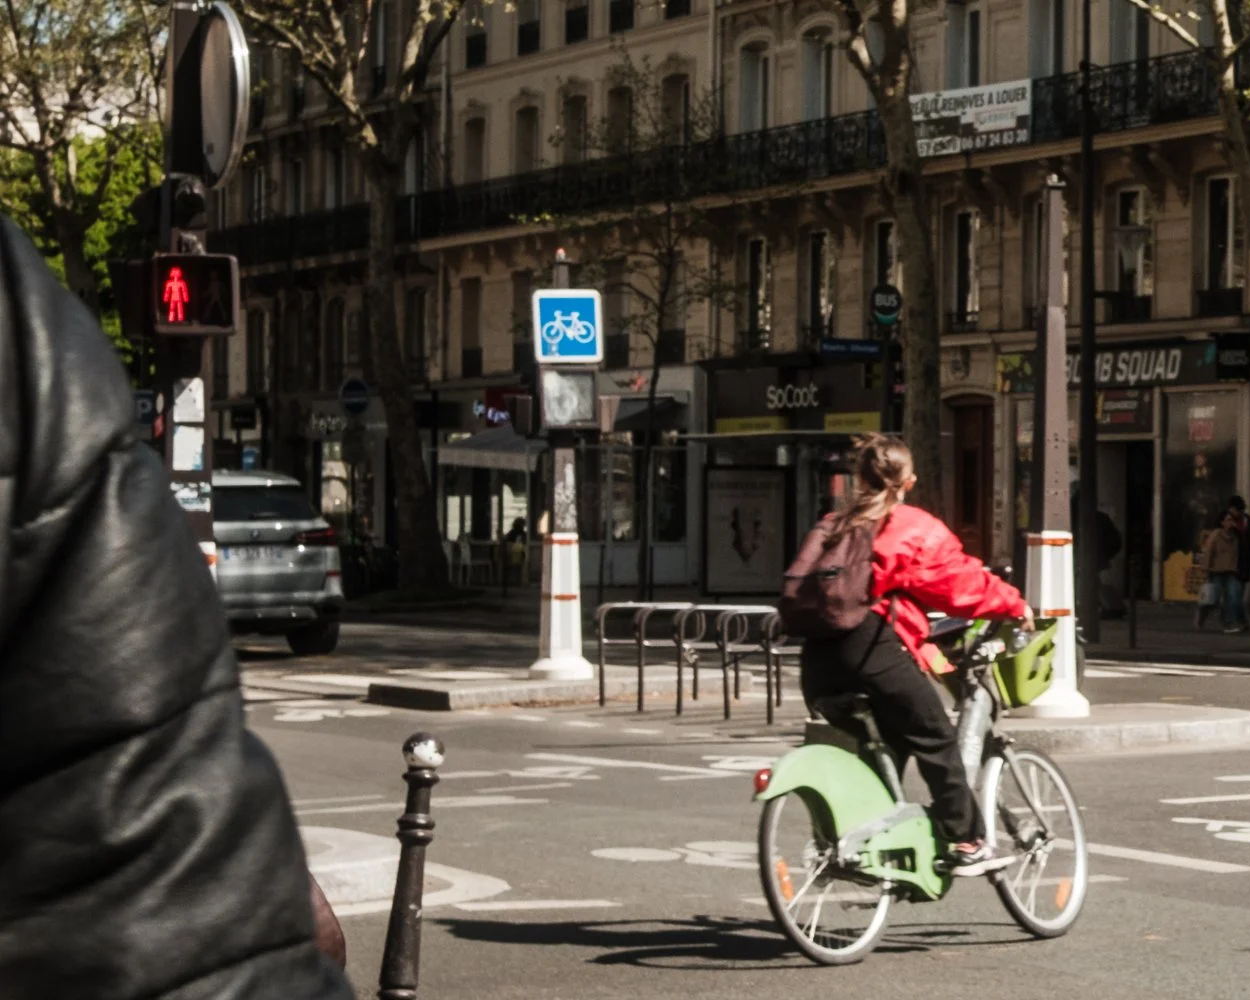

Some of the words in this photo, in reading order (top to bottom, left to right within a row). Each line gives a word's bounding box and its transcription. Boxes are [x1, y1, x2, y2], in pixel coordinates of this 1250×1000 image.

[996, 86, 1027, 105] LOUER
[875, 293, 897, 307] BUS
[1115, 349, 1182, 385] SQUAD
